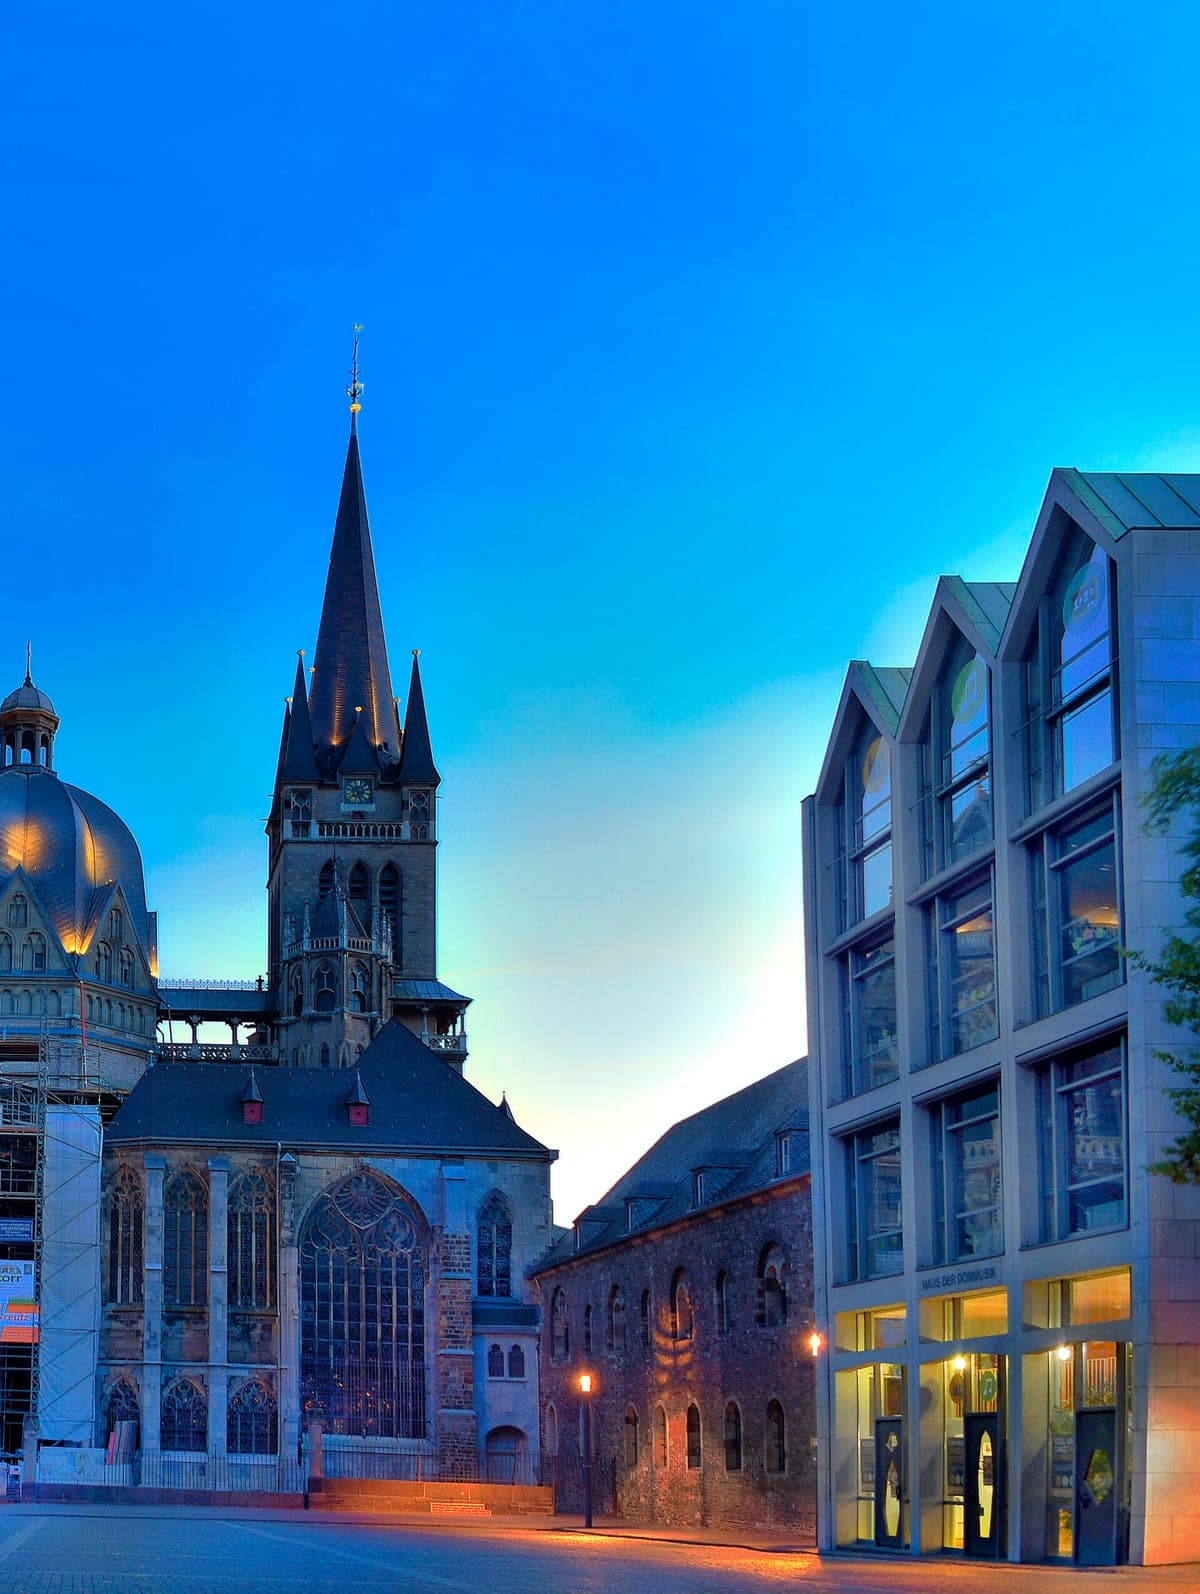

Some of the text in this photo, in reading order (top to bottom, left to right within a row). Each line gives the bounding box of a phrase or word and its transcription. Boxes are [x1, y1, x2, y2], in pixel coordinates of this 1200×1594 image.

[922, 1268, 997, 1289] HAUS DER DOMMUSIK
